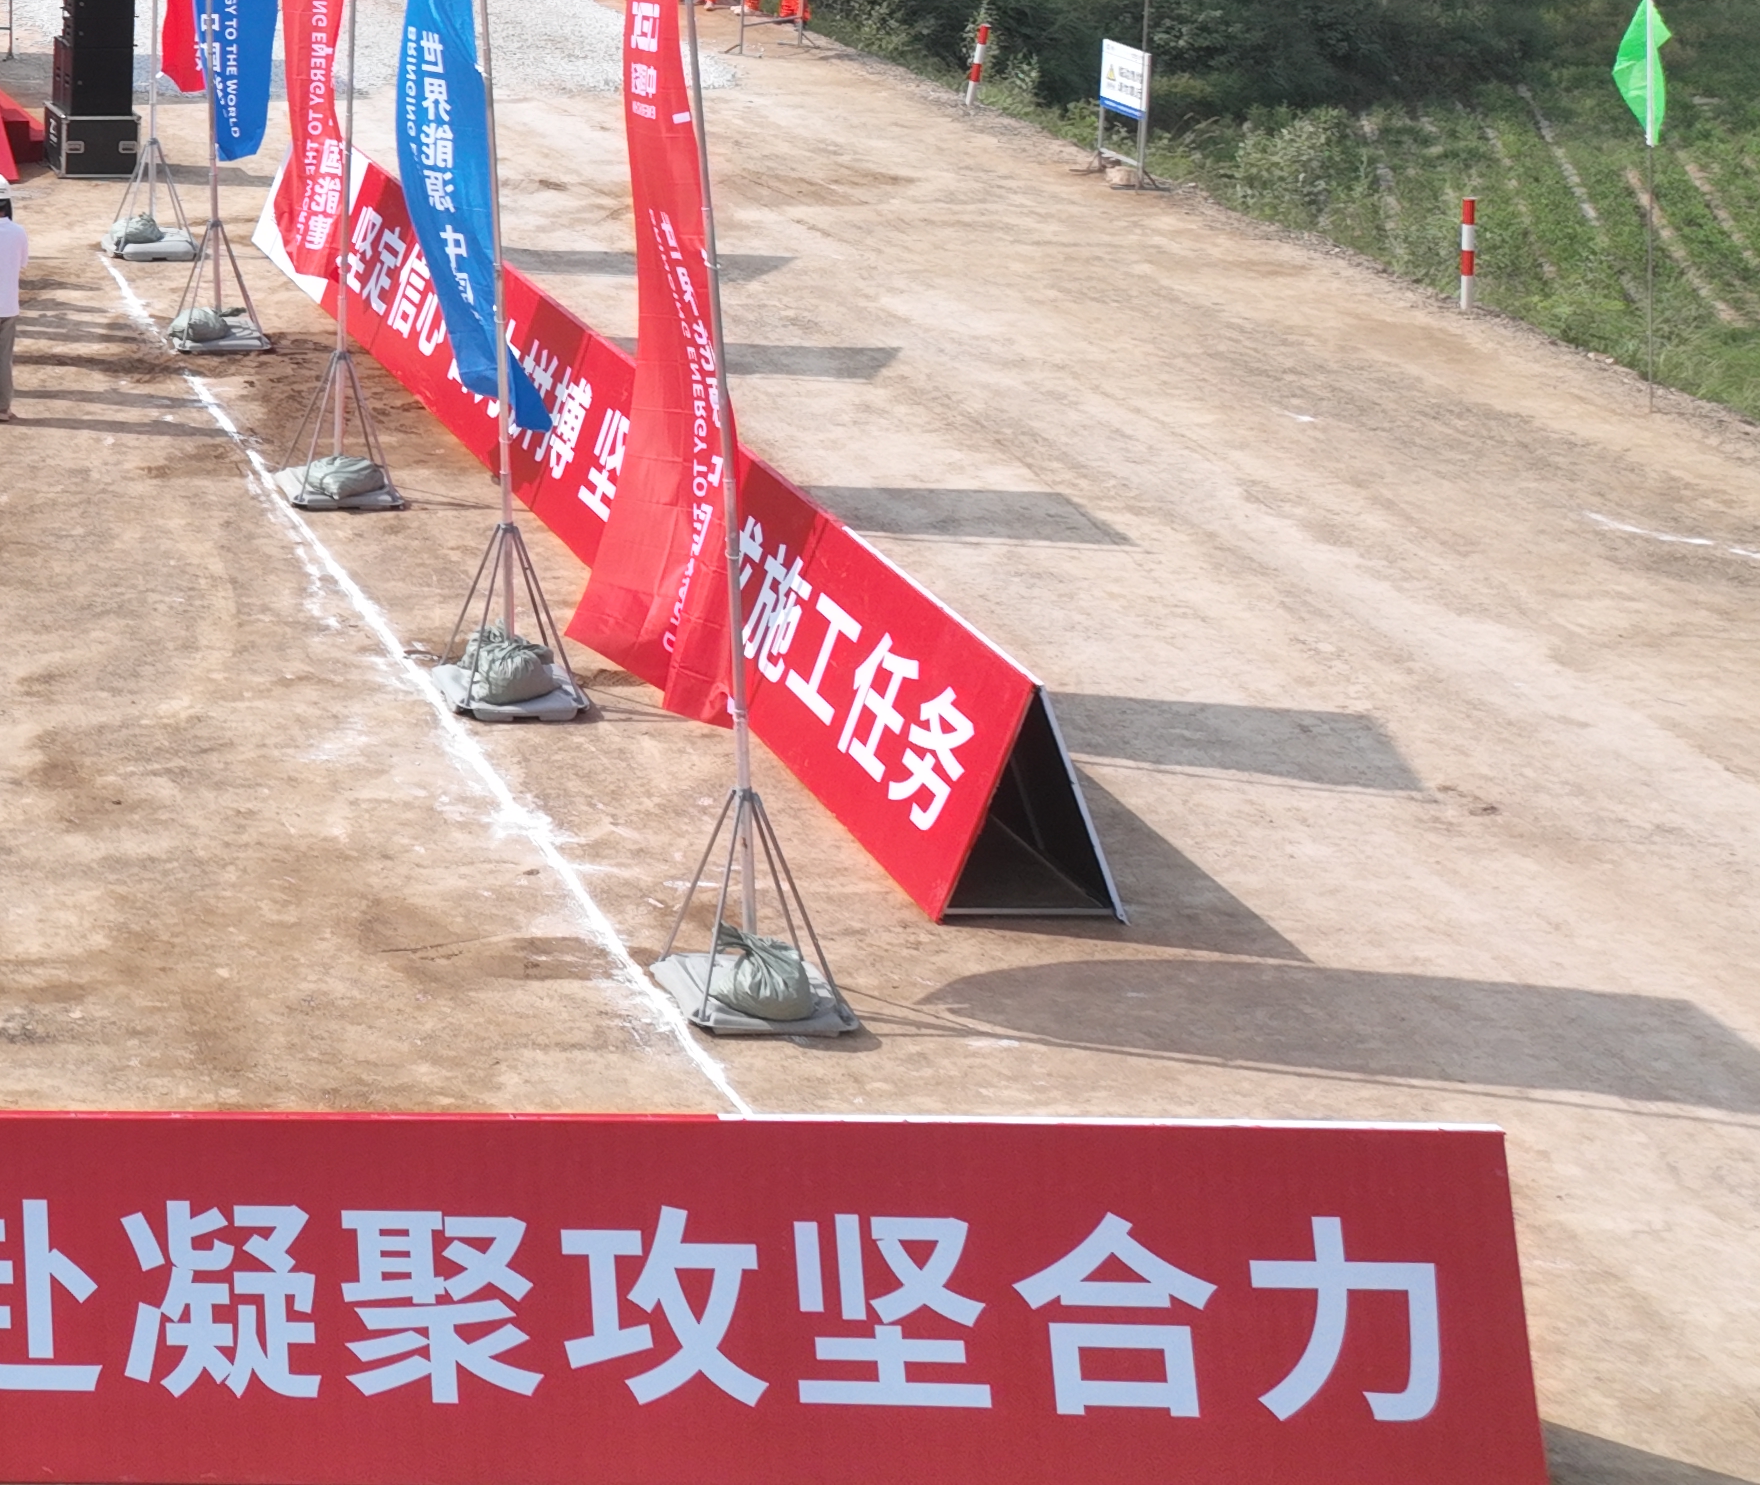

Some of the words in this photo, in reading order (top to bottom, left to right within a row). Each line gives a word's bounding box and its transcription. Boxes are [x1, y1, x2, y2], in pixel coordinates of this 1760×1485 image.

[224, 25, 237, 41] TO
[225, 46, 238, 77] THE
[226, 79, 241, 139] WORLD
